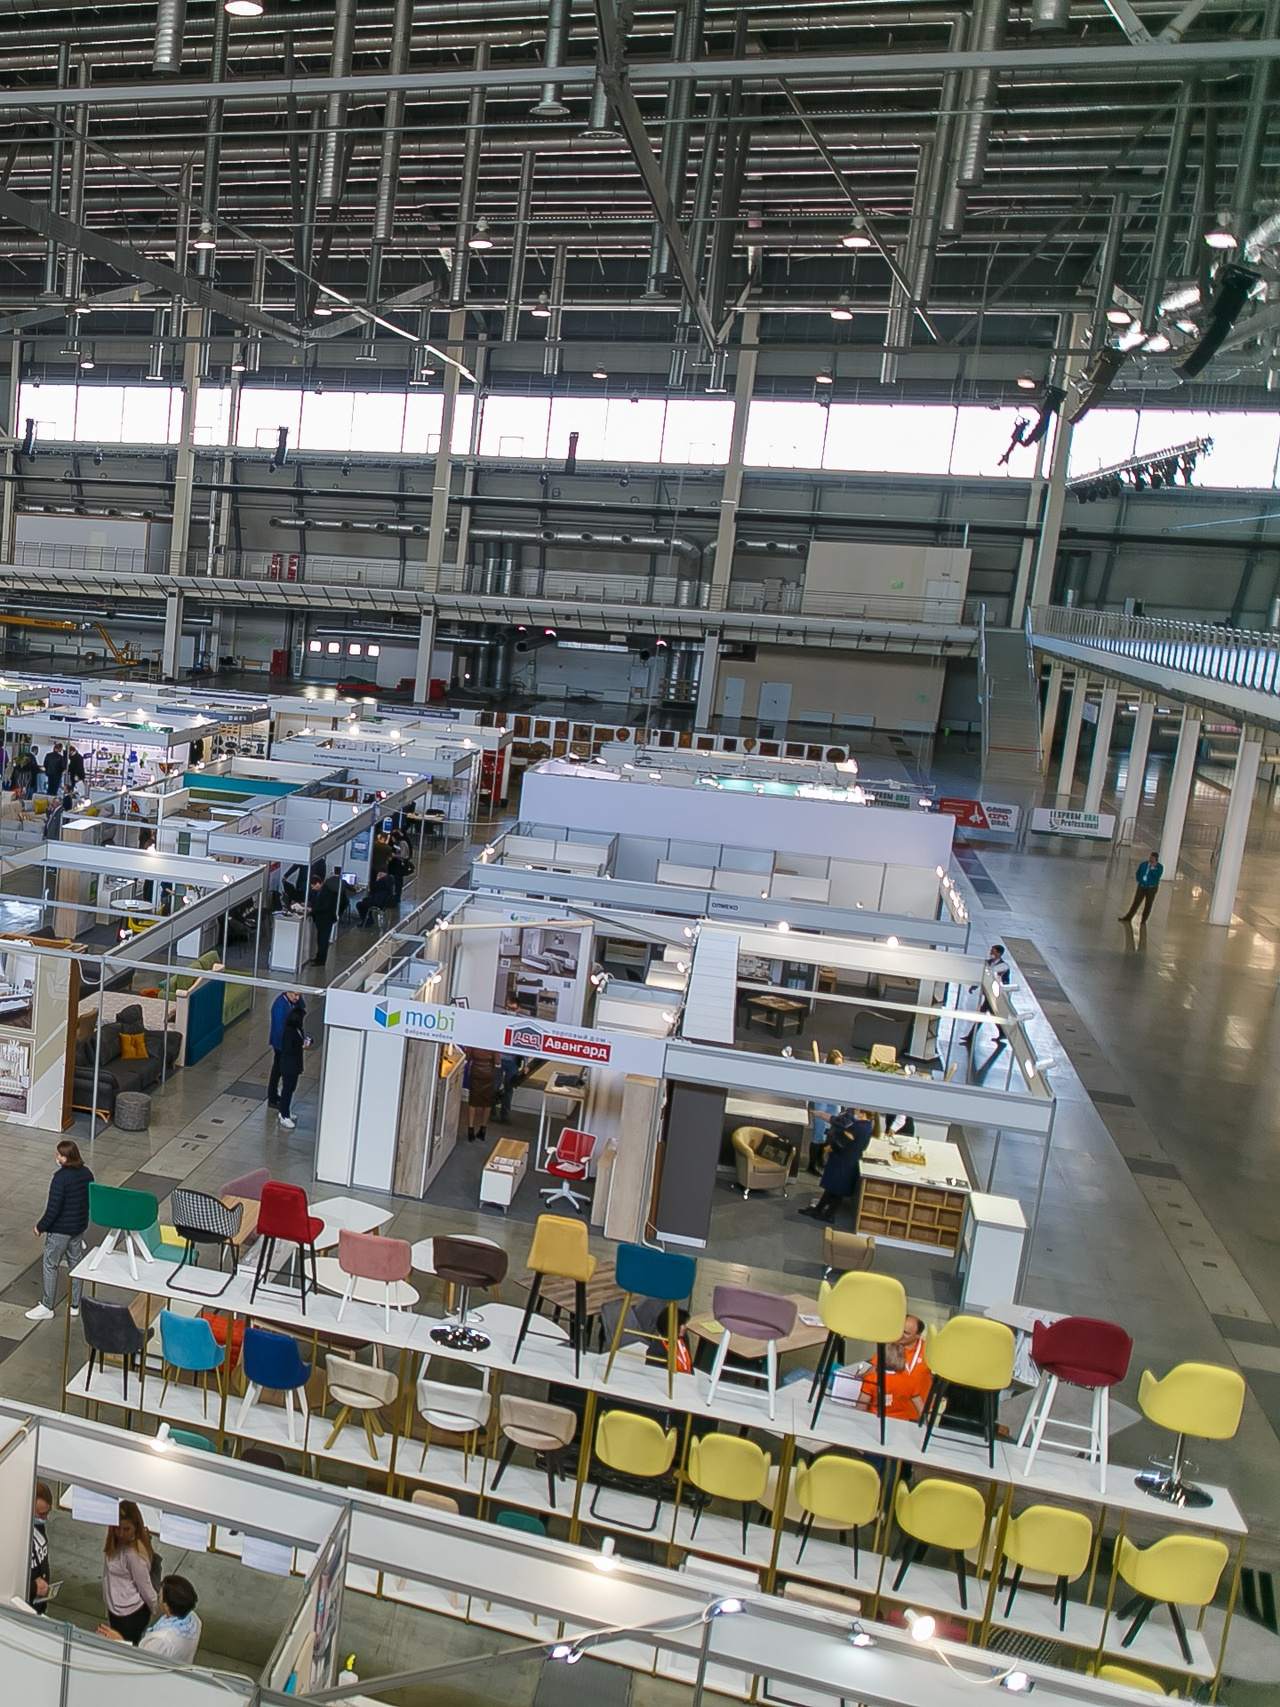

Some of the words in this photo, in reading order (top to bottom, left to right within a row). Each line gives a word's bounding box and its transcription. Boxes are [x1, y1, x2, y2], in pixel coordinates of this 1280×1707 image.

[986, 806, 1013, 815] GRAND
[991, 820, 1011, 828] URAL
[1060, 819, 1099, 830] Professional
[406, 1008, 455, 1032] mobi
[404, 1028, 431, 1037] фабрика
[552, 1029, 588, 1040] торговый
[545, 1037, 608, 1059] Авангард
